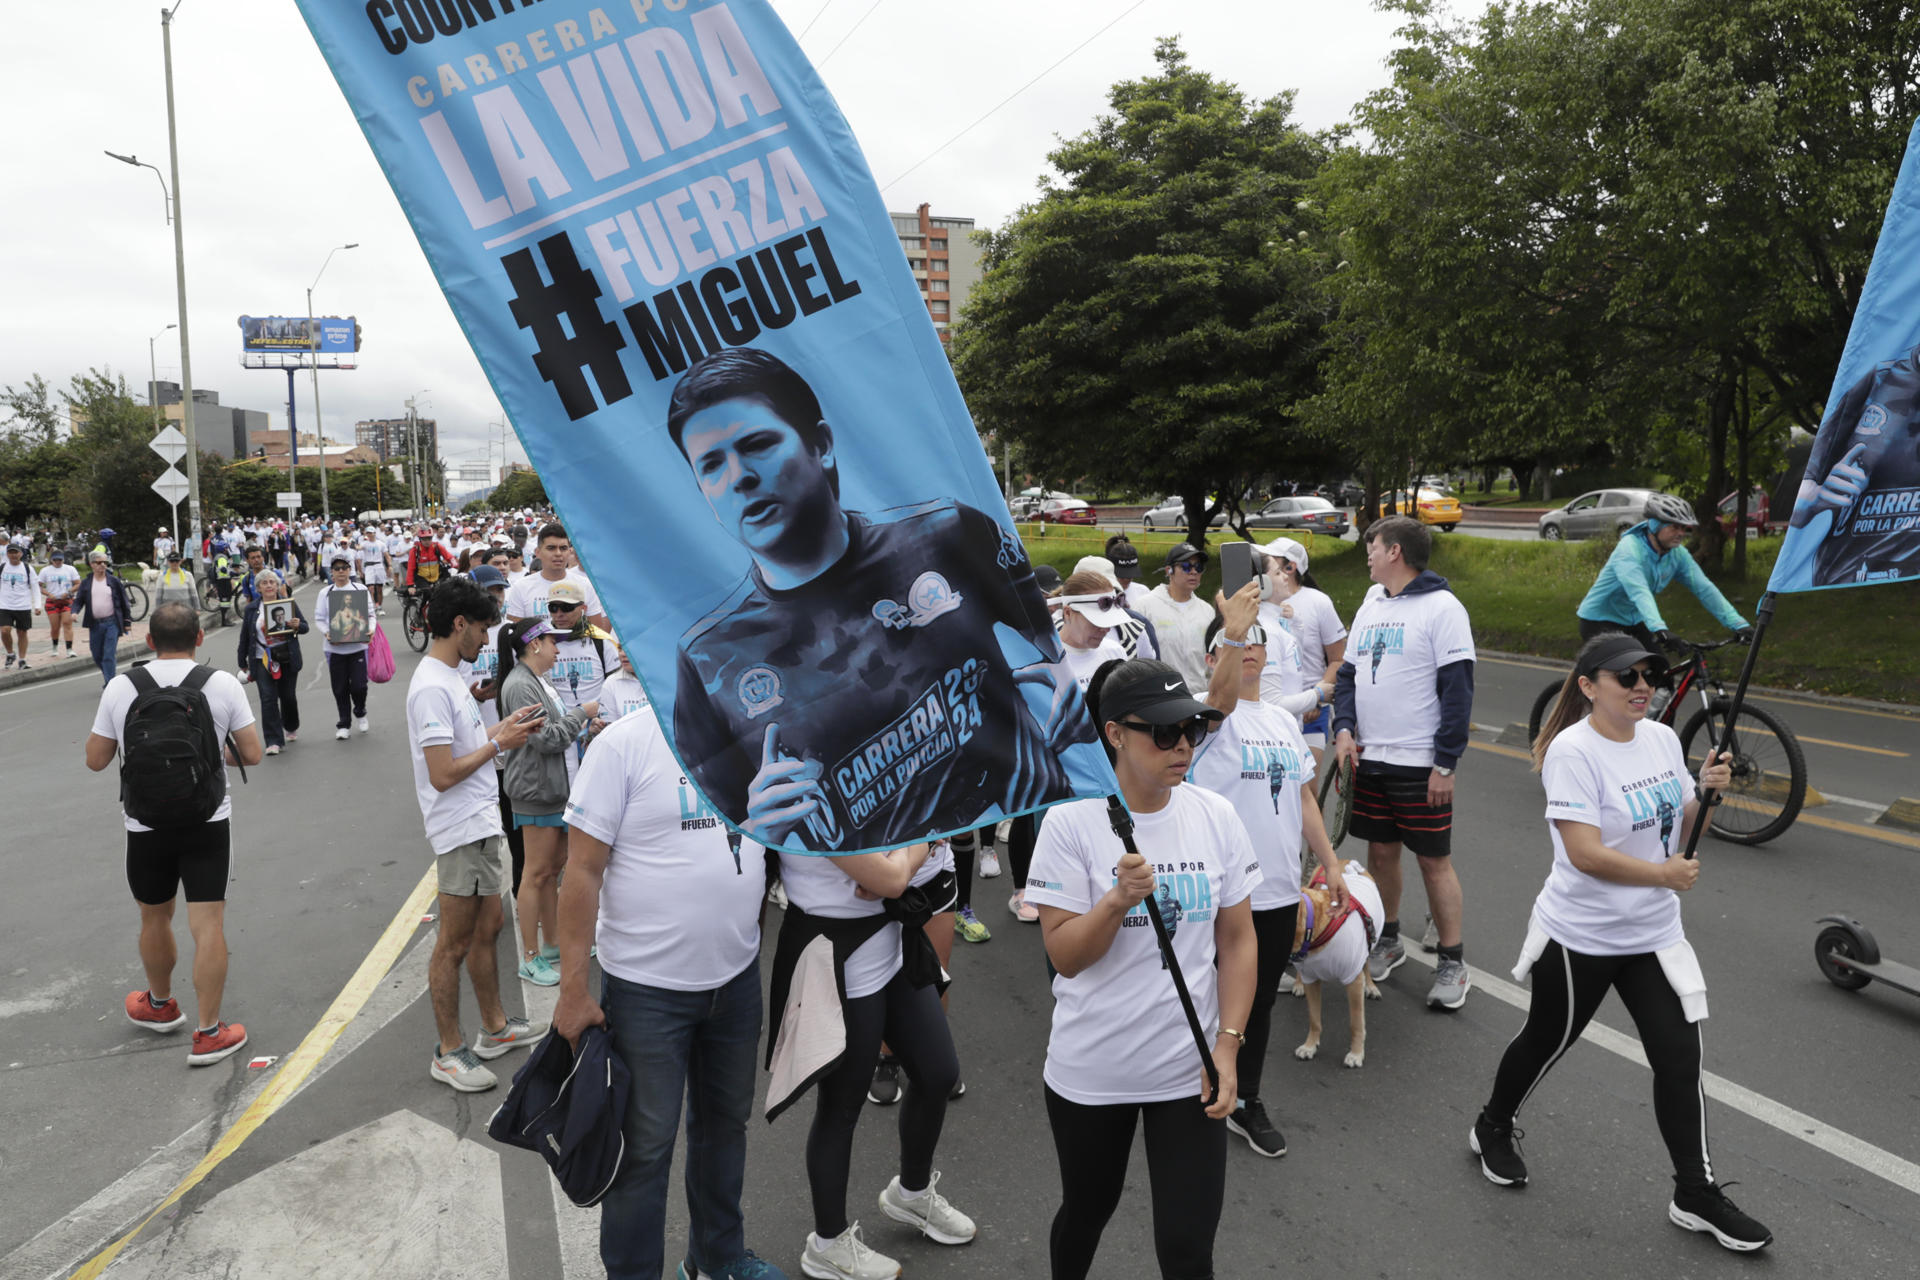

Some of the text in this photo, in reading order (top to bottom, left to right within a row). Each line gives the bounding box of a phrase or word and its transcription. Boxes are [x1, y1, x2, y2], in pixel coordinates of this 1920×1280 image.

[407, 8, 618, 108] CARRERA
[418, 2, 782, 230] LA VIDA
[584, 146, 829, 302] FUERZA
[622, 226, 862, 382] MIGUEL
[1853, 519, 1876, 533] POR
[1877, 518, 1891, 531] LA
[837, 693, 945, 799] CARRERA
[1241, 745, 1265, 771] LA
[850, 790, 878, 824] POR
[877, 775, 896, 800] LA
[1624, 790, 1654, 822] LA
[681, 818, 717, 831] #FUERZA
[1112, 861, 1205, 876] CERA POR
[1122, 910, 1212, 928] UERZA MIGUEL
